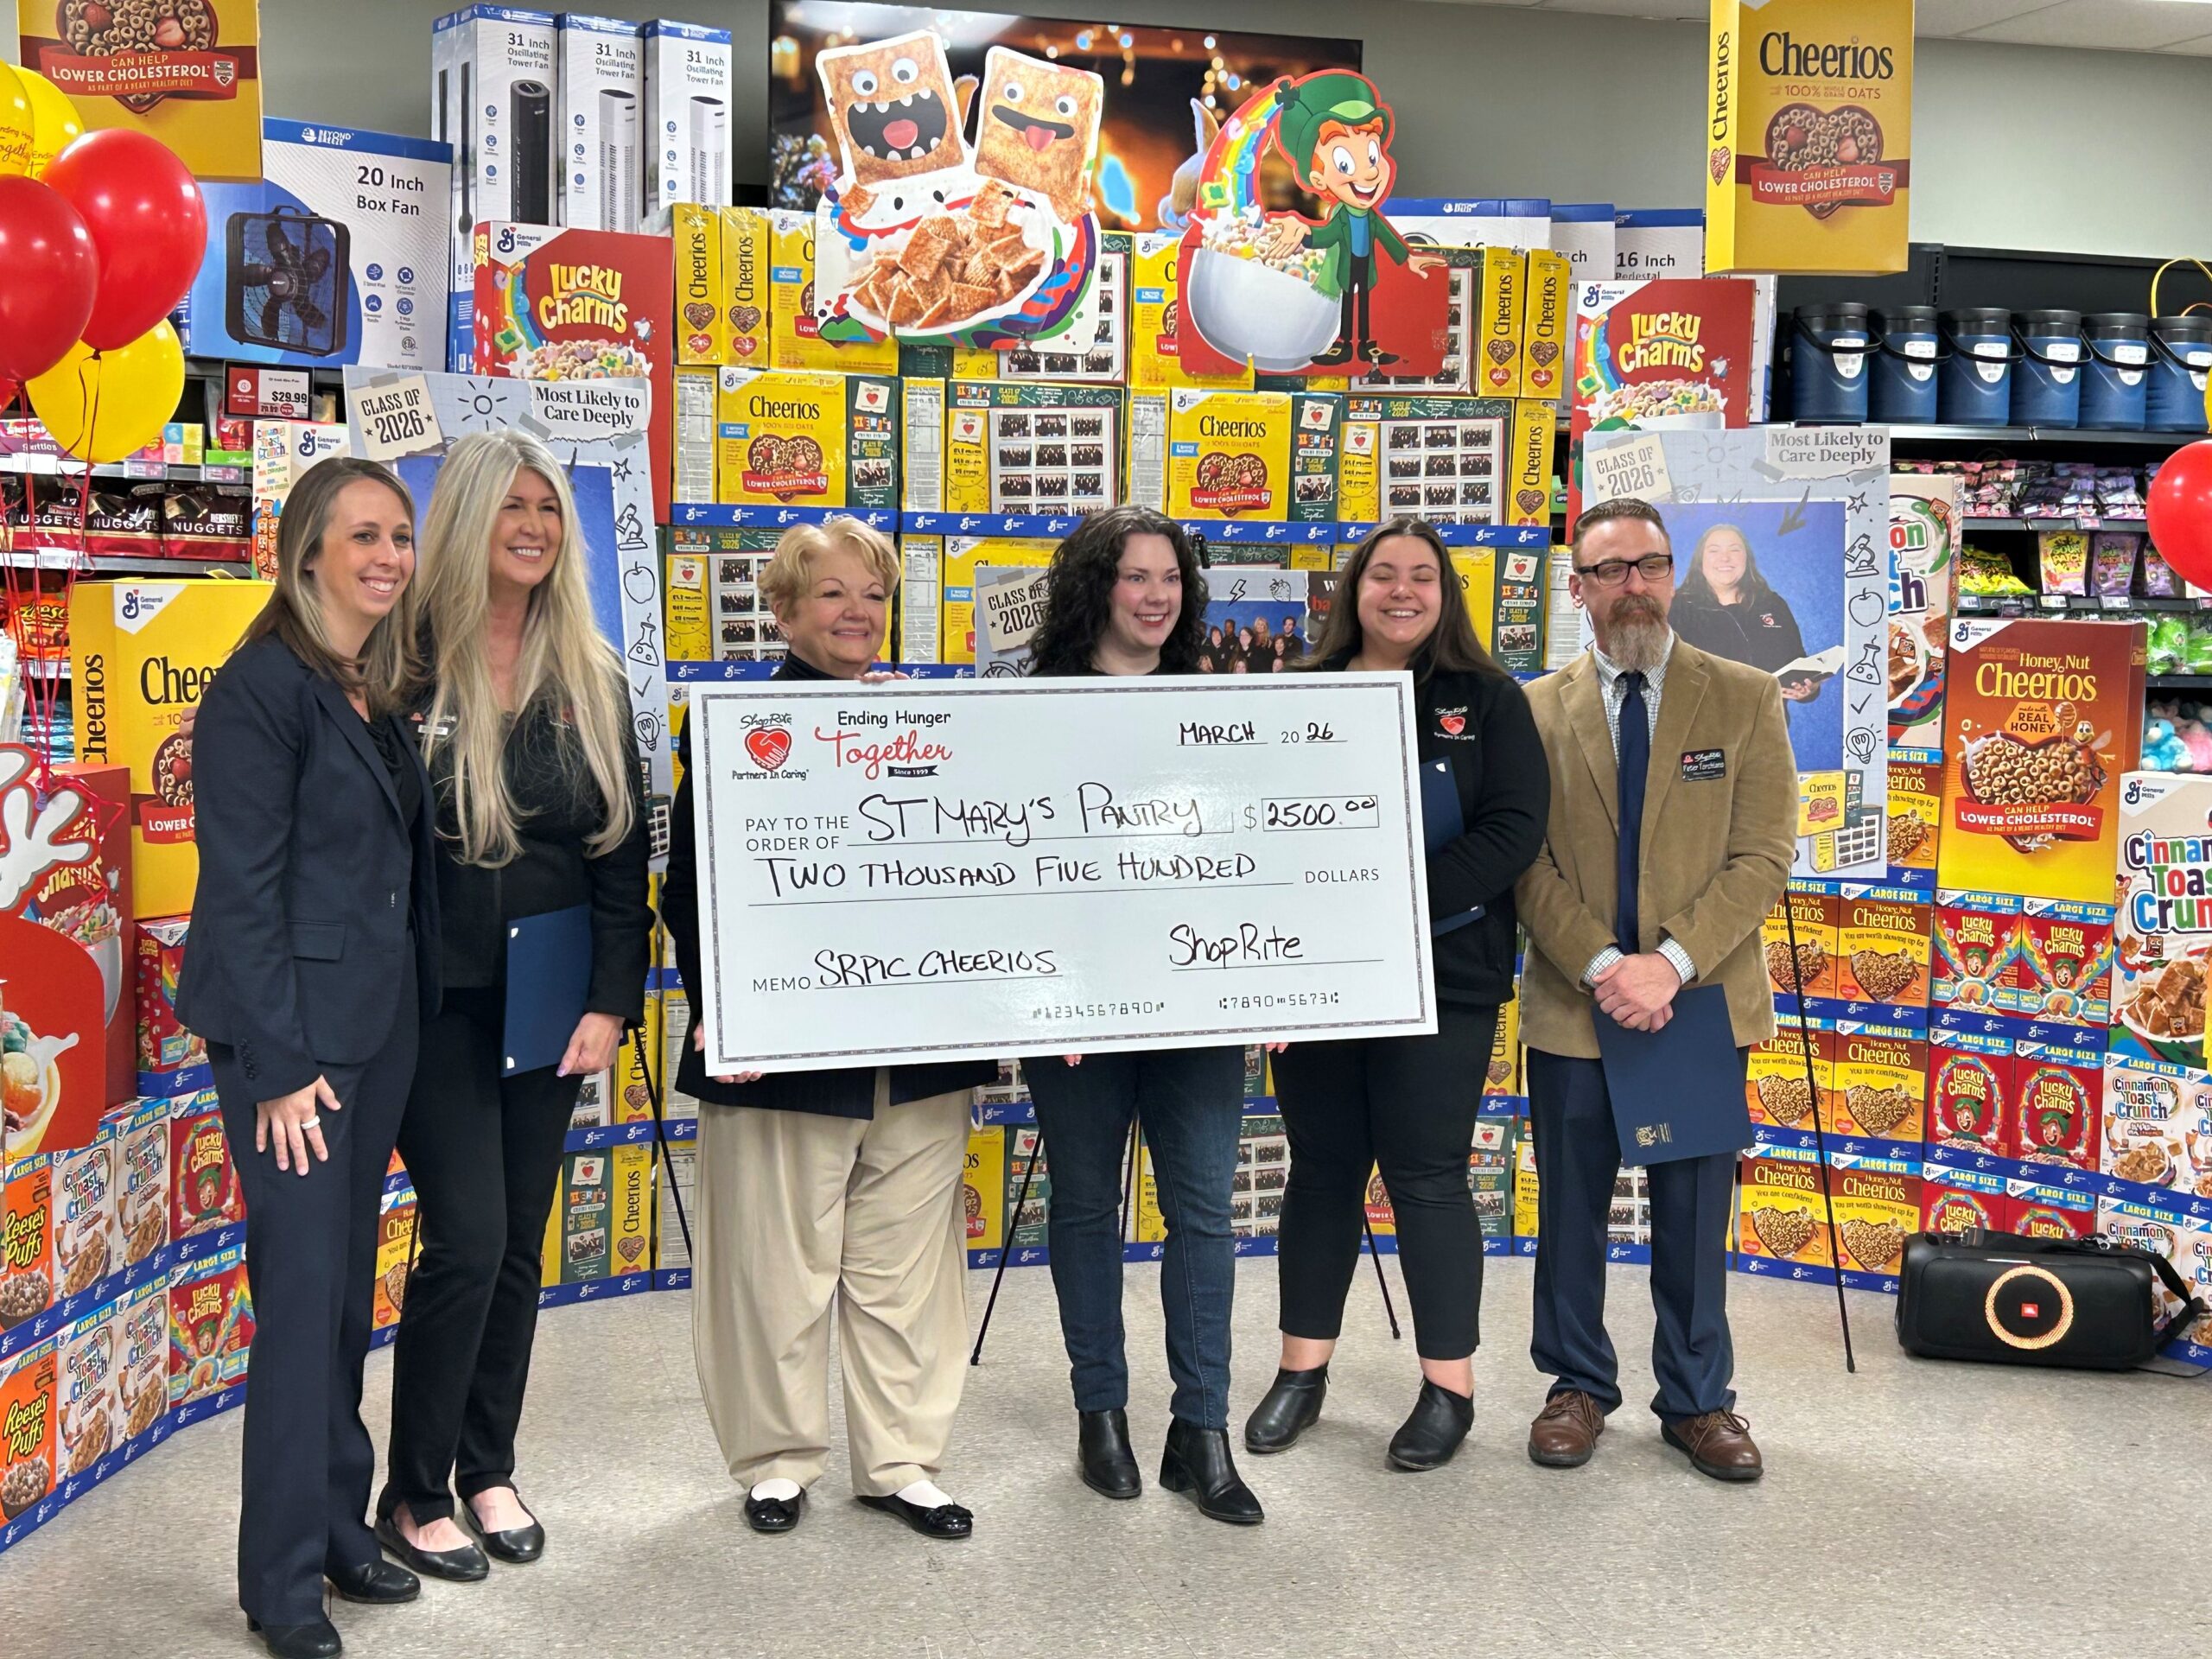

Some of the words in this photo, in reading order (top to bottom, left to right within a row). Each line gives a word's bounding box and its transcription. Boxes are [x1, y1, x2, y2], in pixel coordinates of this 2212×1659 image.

[508, 33, 524, 47] 31
[529, 38, 550, 50] Inch
[111, 56, 134, 67] CAN
[137, 54, 168, 65] HELP
[507, 48, 550, 60] Oscillating
[595, 43, 611, 57] 31
[615, 48, 636, 60] Inch
[686, 50, 702, 63] 31
[706, 56, 724, 67] Inch
[1759, 32, 1894, 79] Cheerios
[507, 59, 531, 69] Tower
[534, 59, 549, 69] Fan
[595, 58, 635, 71] Oscillating
[686, 65, 724, 78] Oscillating
[51, 66, 105, 81] LOWER
[595, 68, 619, 79] Tower
[620, 70, 635, 79] Fan
[686, 74, 709, 85] Tower
[711, 76, 724, 86] Fan
[1713, 31, 1730, 141] Cheerios
[1785, 85, 1821, 97] 100%
[1847, 88, 1881, 99] OATS
[358, 167, 384, 185] 20
[391, 174, 424, 193] Inch
[1758, 181, 1798, 194] LOWER
[1800, 177, 1874, 192] CHOLESTEROL
[357, 194, 386, 213] Box
[391, 199, 420, 216] Fan
[689, 232, 706, 298] Cheerios
[1616, 251, 1638, 267] 16
[1645, 255, 1675, 267] Inch
[735, 237, 753, 302] Cheerios
[550, 264, 622, 302] Lucky
[539, 296, 628, 334] Charms
[1536, 277, 1556, 337] Cheerios
[1630, 312, 1701, 345] Lucky
[1618, 342, 1705, 373] Charms
[272, 391, 307, 403] $29.99
[361, 396, 402, 416] CLASS
[404, 389, 420, 407] OF
[536, 387, 572, 404] Most
[576, 391, 621, 410] Likely
[625, 396, 639, 408] to
[749, 395, 820, 419] Cheerios
[543, 405, 580, 422] Care
[583, 408, 633, 429] Deeply
[374, 410, 425, 444] 2026
[1199, 415, 1267, 438] Cheerios
[1771, 433, 1808, 447] Most
[1814, 433, 1863, 448] Likely
[1867, 433, 1883, 446] to
[1522, 426, 1543, 486] Cheerios
[1597, 455, 1636, 475] CLASS
[1638, 447, 1653, 463] OF
[1779, 450, 1815, 463] Care
[1820, 449, 1876, 465] Deeply
[1608, 466, 1656, 497] 2026
[92, 518, 160, 531] NUGGETS
[174, 522, 243, 535] NUGGETS
[988, 588, 1026, 610] CLASS
[2019, 652, 2061, 671] Honey
[2065, 655, 2090, 670] Nut
[141, 657, 224, 705] Chee
[1975, 663, 2097, 702] Cheerios
[740, 713, 791, 729] ShopRite
[838, 710, 887, 728] Ending
[895, 710, 951, 725] Hunger
[2018, 713, 2050, 722] REAL
[1179, 721, 1255, 745] MARCH
[1306, 722, 1333, 741] 26
[2011, 721, 2056, 733] HONEY
[1281, 732, 1300, 744] 20
[814, 727, 952, 780] Together
[1910, 751, 1928, 762] SIZE
[732, 771, 767, 780] Partners
[770, 770, 779, 779] In
[149, 818, 188, 831] LOWER
[746, 818, 777, 831] PAY
[784, 817, 808, 830] TO
[814, 816, 849, 829] THE
[858, 794, 928, 842] ST
[1243, 804, 1257, 832] $
[1961, 812, 2004, 824] LOWER
[746, 837, 810, 851] ORDER
[817, 836, 839, 849] OF
[859, 860, 1016, 888] THOUSAND
[1036, 855, 1102, 887] FIVE
[1117, 851, 1255, 880] HUNDRED
[1305, 868, 1379, 884] DOLLARS
[1808, 884, 1826, 893] SIZE
[1871, 889, 1897, 899] LARGE
[1899, 891, 1917, 901] SIZE
[2055, 904, 2082, 914] LARGE
[2135, 893, 2212, 932] Crun
[1853, 908, 1916, 931] Cheerios
[1962, 917, 1993, 933] Lucky
[1956, 931, 1994, 947] Charms
[2050, 926, 2084, 944] Lucky
[1169, 923, 1304, 969] ShopRite
[2044, 939, 2085, 957] Charms
[814, 949, 912, 987] SRPIC
[918, 950, 1057, 977] CHEERIOS
[753, 977, 811, 992] MEMO
[1848, 1044, 1910, 1066] Cheerios
[2128, 1058, 2156, 1071] LARGE
[2159, 1063, 2178, 1075] SIZE
[1954, 1068, 1984, 1086] Lucky
[2114, 1078, 2168, 1092] Cinnamon
[1948, 1082, 1986, 1100] Charms
[2040, 1081, 2073, 1099] Lucky
[2124, 1091, 2158, 1104] Toast
[2034, 1095, 2075, 1115] Charms
[2117, 1103, 2168, 1120] Crunch
[194, 1132, 222, 1156] Lucky
[191, 1149, 224, 1173] Charms
[1770, 1147, 1797, 1159] LARGE
[1798, 1150, 1816, 1160] SIZE
[130, 1159, 162, 1194] Crunch
[1754, 1166, 1815, 1189] Cheerios
[1949, 1171, 1976, 1181] LARGE
[1843, 1178, 1906, 1201] Cheerios
[66, 1180, 105, 1223] Crunch
[623, 1170, 641, 1233] Cheerios
[2123, 1203, 2152, 1217] LARGE
[1945, 1204, 1976, 1224] Lucky
[387, 1218, 414, 1239] Chee
[2109, 1224, 2164, 1239] Cinnamon
[7, 1232, 41, 1268] Puffs
[192, 1285, 219, 1306] Lucky
[188, 1300, 222, 1324] Charms
[3, 1392, 48, 1438] Reese's
[9, 1420, 43, 1464] Puffs
